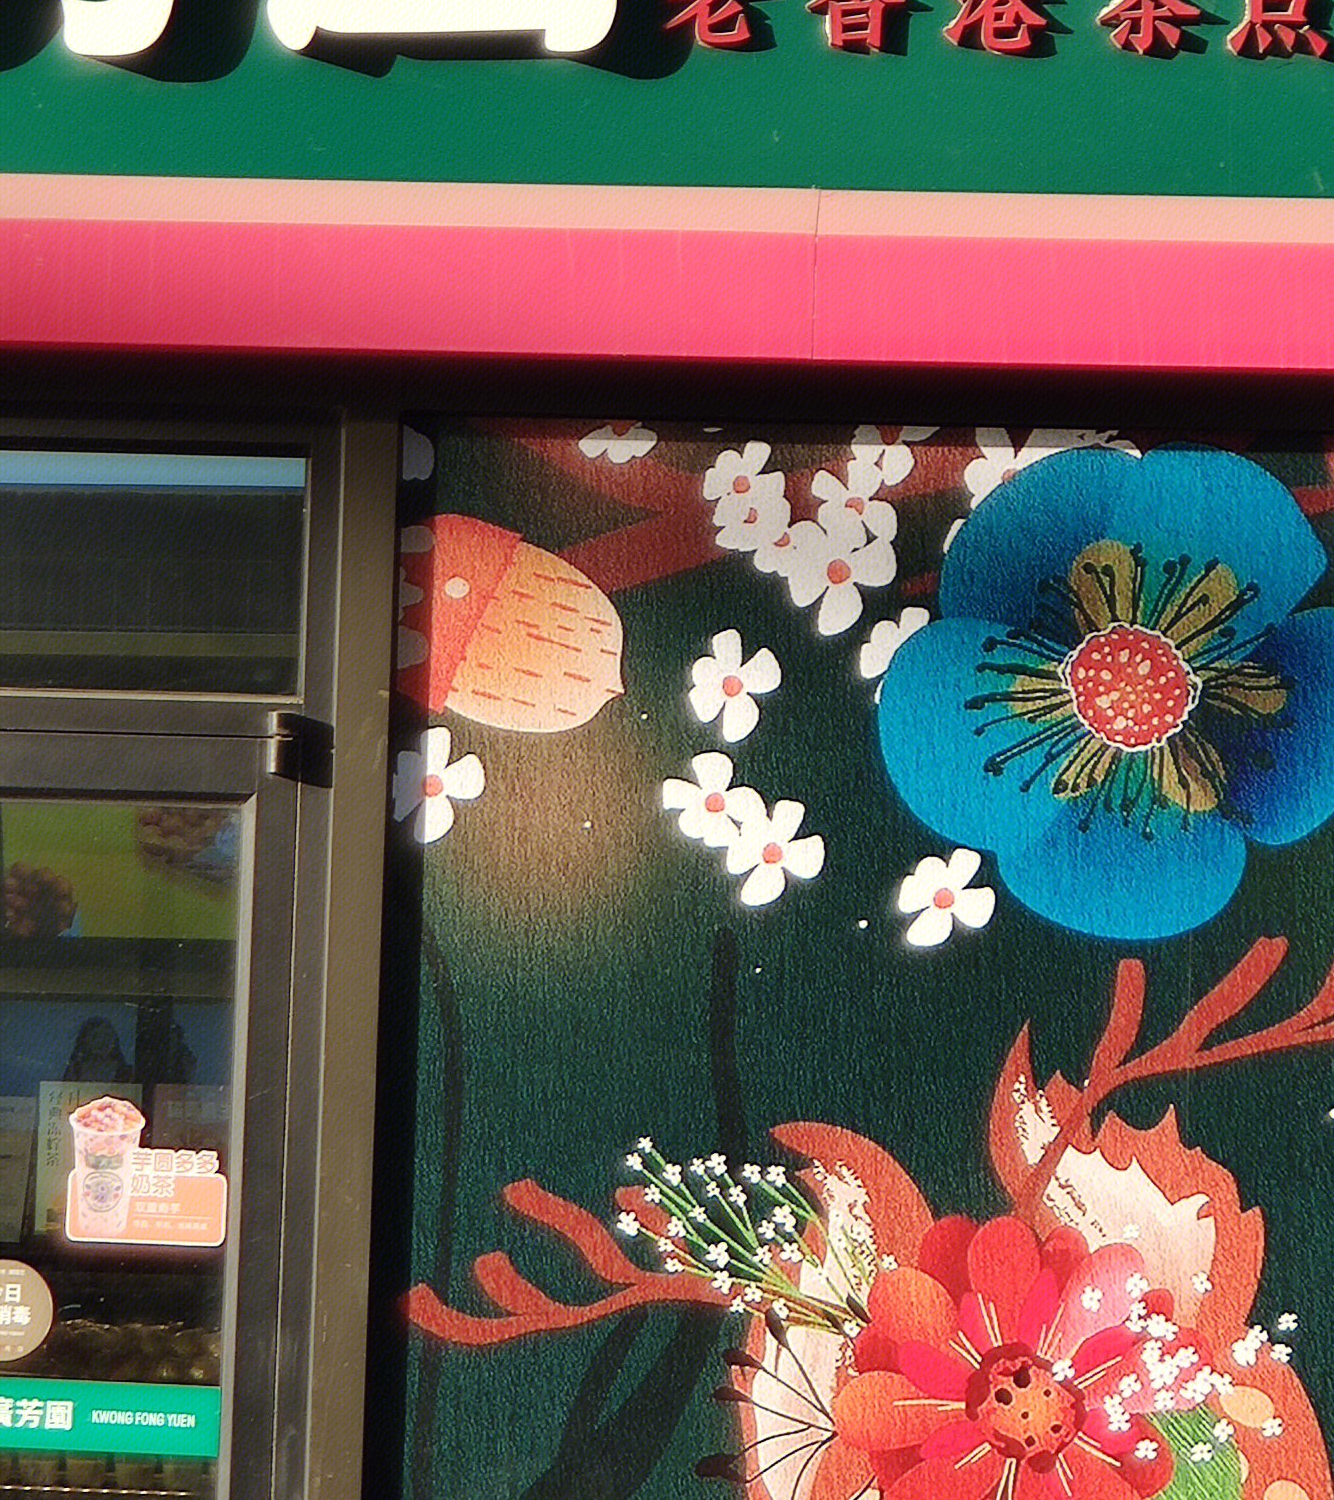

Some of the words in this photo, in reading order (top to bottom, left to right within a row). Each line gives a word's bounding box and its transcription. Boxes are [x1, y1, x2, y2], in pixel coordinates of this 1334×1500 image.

[131, 1151, 216, 1174] 芋圆多多
[130, 1173, 173, 1195] 奶茶
[91, 1410, 134, 1425] KWONG
[134, 1411, 165, 1427] FONG
[166, 1413, 196, 1428] YUEN
